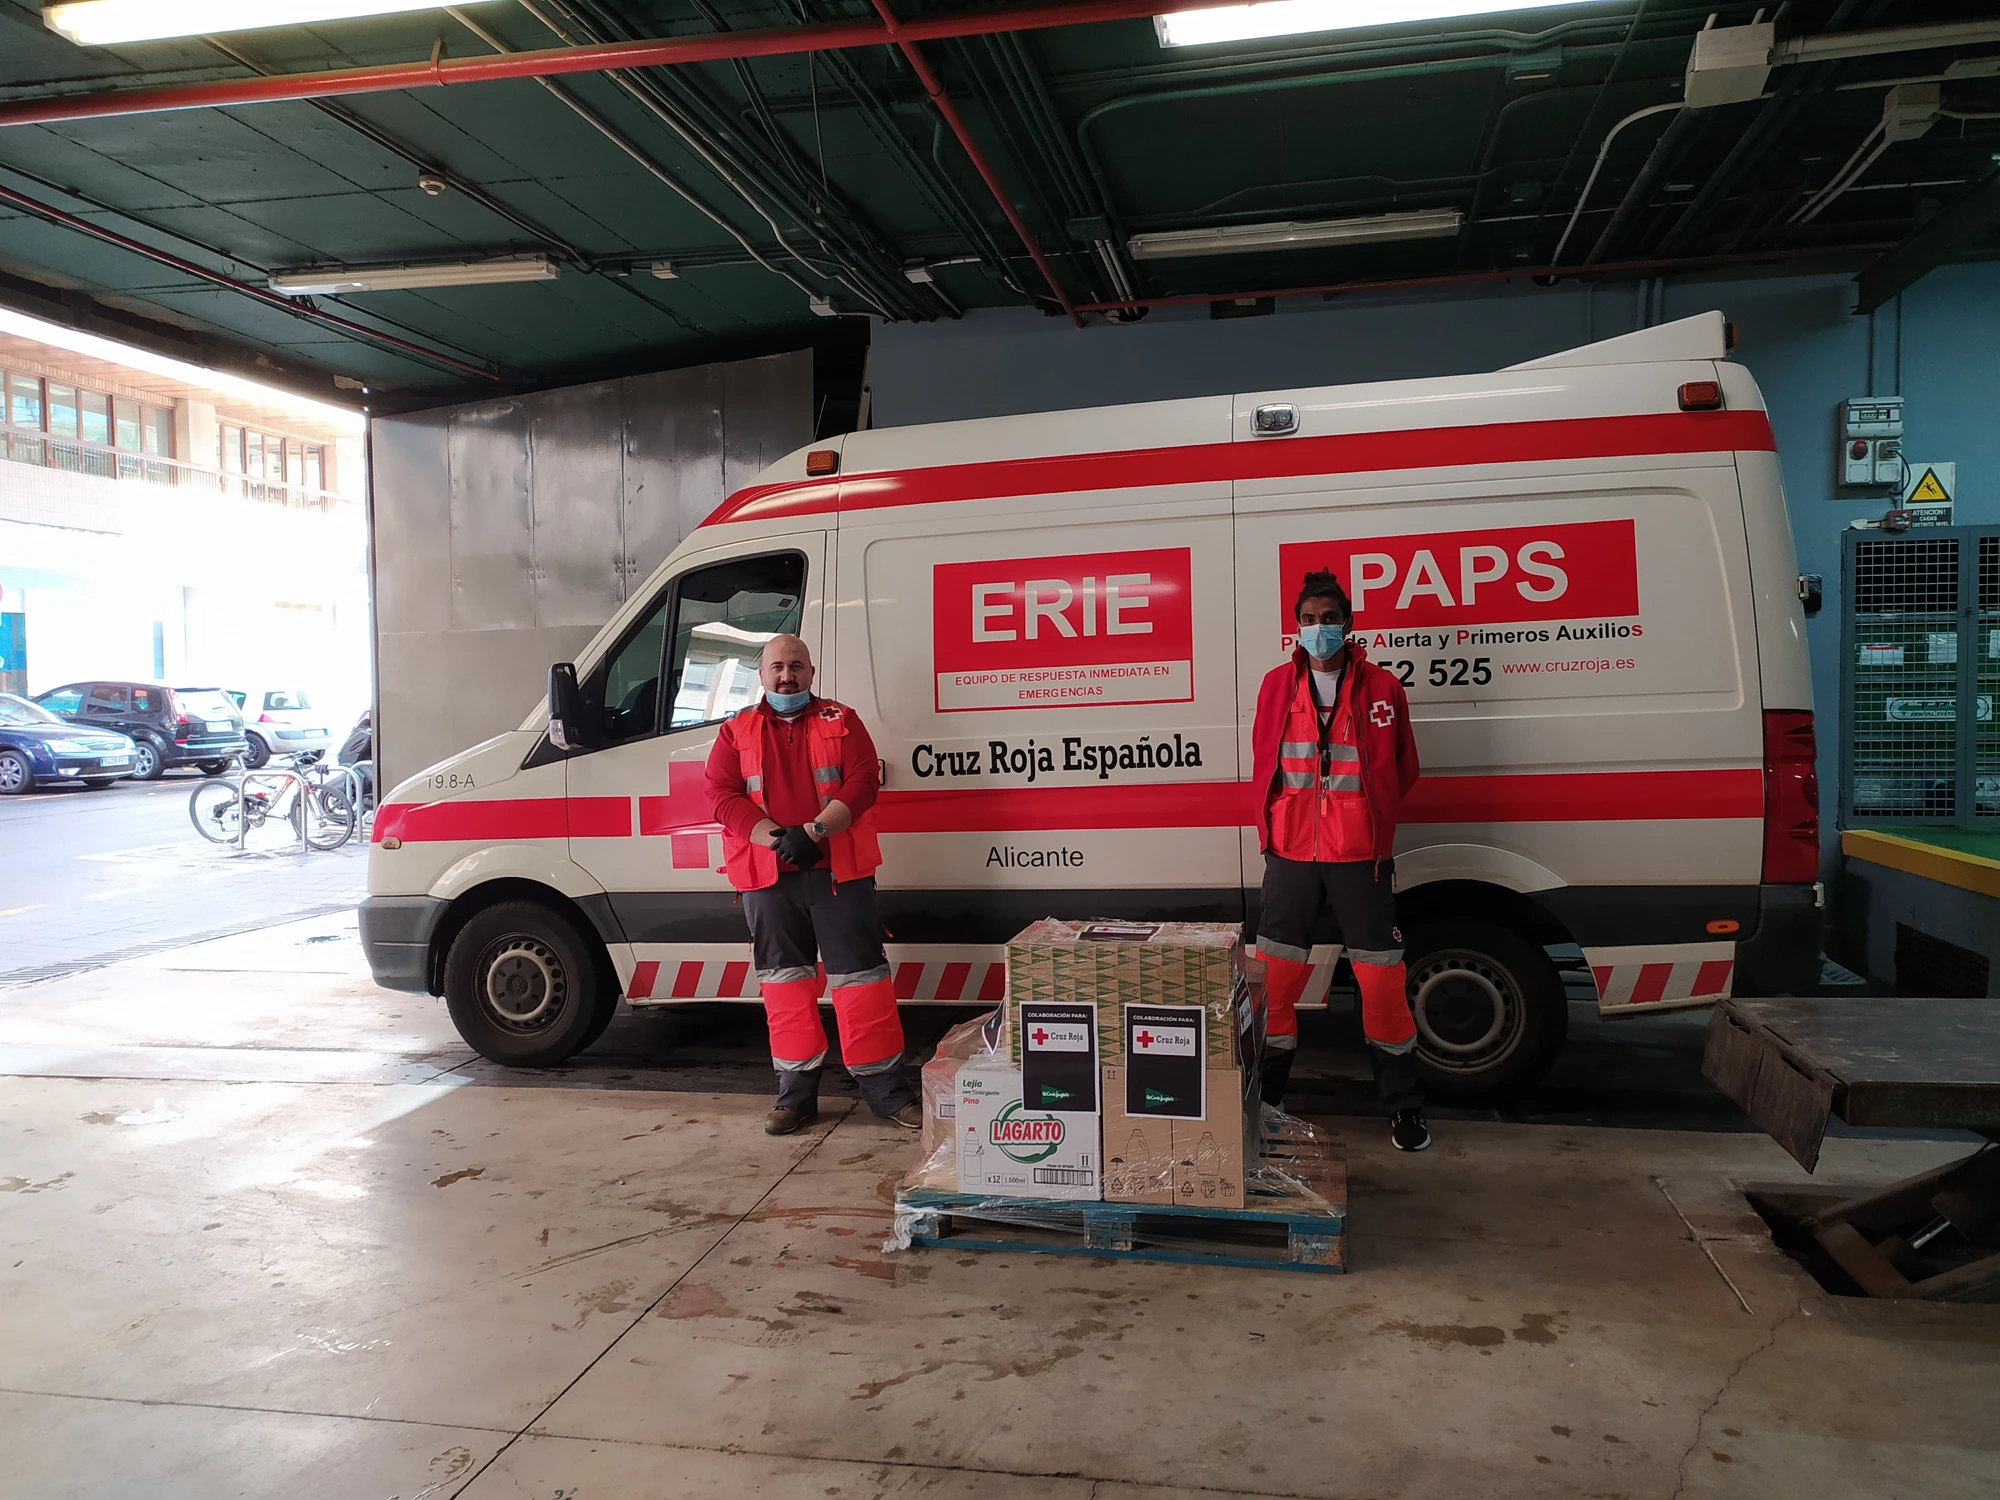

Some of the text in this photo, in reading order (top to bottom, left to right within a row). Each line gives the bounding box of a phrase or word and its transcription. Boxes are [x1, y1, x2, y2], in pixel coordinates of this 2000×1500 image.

[1350, 540, 1569, 612] PAPS
[972, 572, 1153, 643] ERIE
[1372, 632, 1432, 649] Alerta
[1438, 634, 1450, 651] y
[1456, 629, 1550, 646] Primeros
[1555, 622, 1643, 641] Auxilios
[955, 665, 1170, 686] EQUIPO DE RESPUESTA INMEDIATA EN
[1428, 657, 1492, 687] 525
[1502, 657, 1635, 674] www.cruzroja.es
[1018, 686, 1103, 699] EMERGENCIAS
[912, 733, 1202, 782] Cruz Roja Española
[985, 846, 1084, 868] Alicante
[1133, 1014, 1178, 1022] COLABORACIÓN
[1050, 1032, 1084, 1043] Cruz Roja
[1156, 1035, 1190, 1046] Cruz Roja
[963, 1080, 982, 1089] Lejía
[993, 1122, 1062, 1141] LAGARTO
